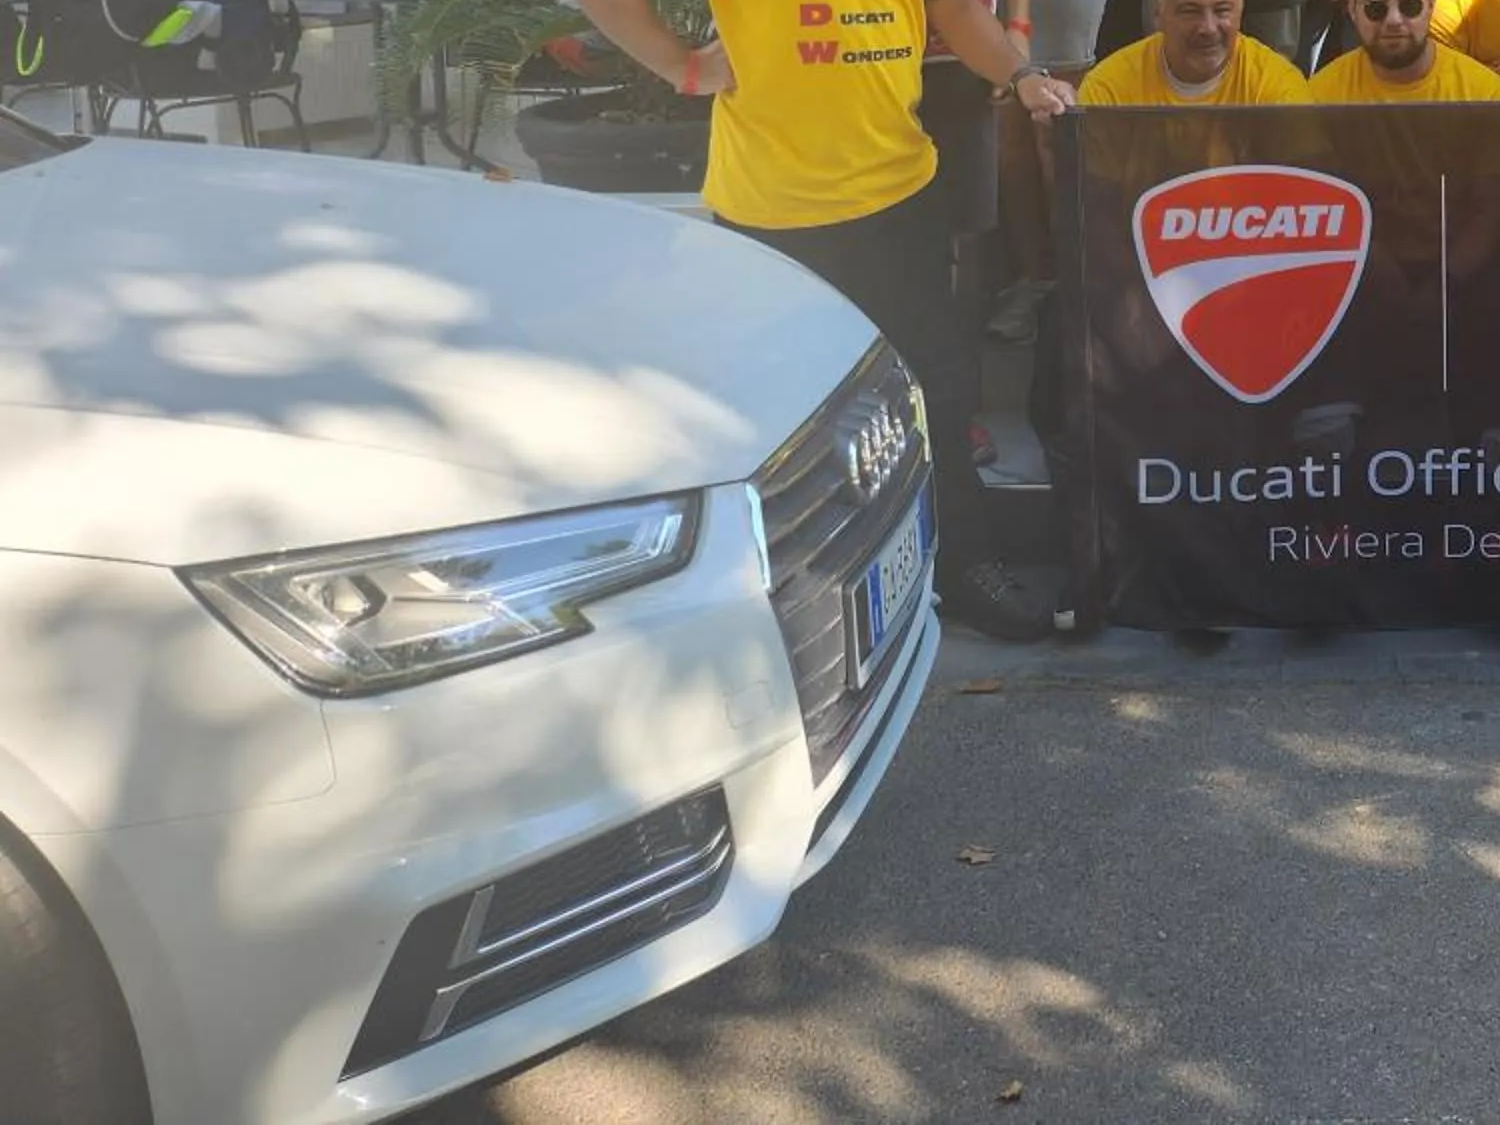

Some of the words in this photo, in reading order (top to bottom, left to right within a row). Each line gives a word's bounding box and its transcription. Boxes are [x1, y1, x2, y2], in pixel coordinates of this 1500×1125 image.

[800, 3, 895, 26] DUCATI
[797, 41, 912, 65] WONDERS
[1160, 205, 1345, 240] DUCATI
[1138, 452, 1342, 505] Ducati
[1268, 523, 1424, 562] Riviera
